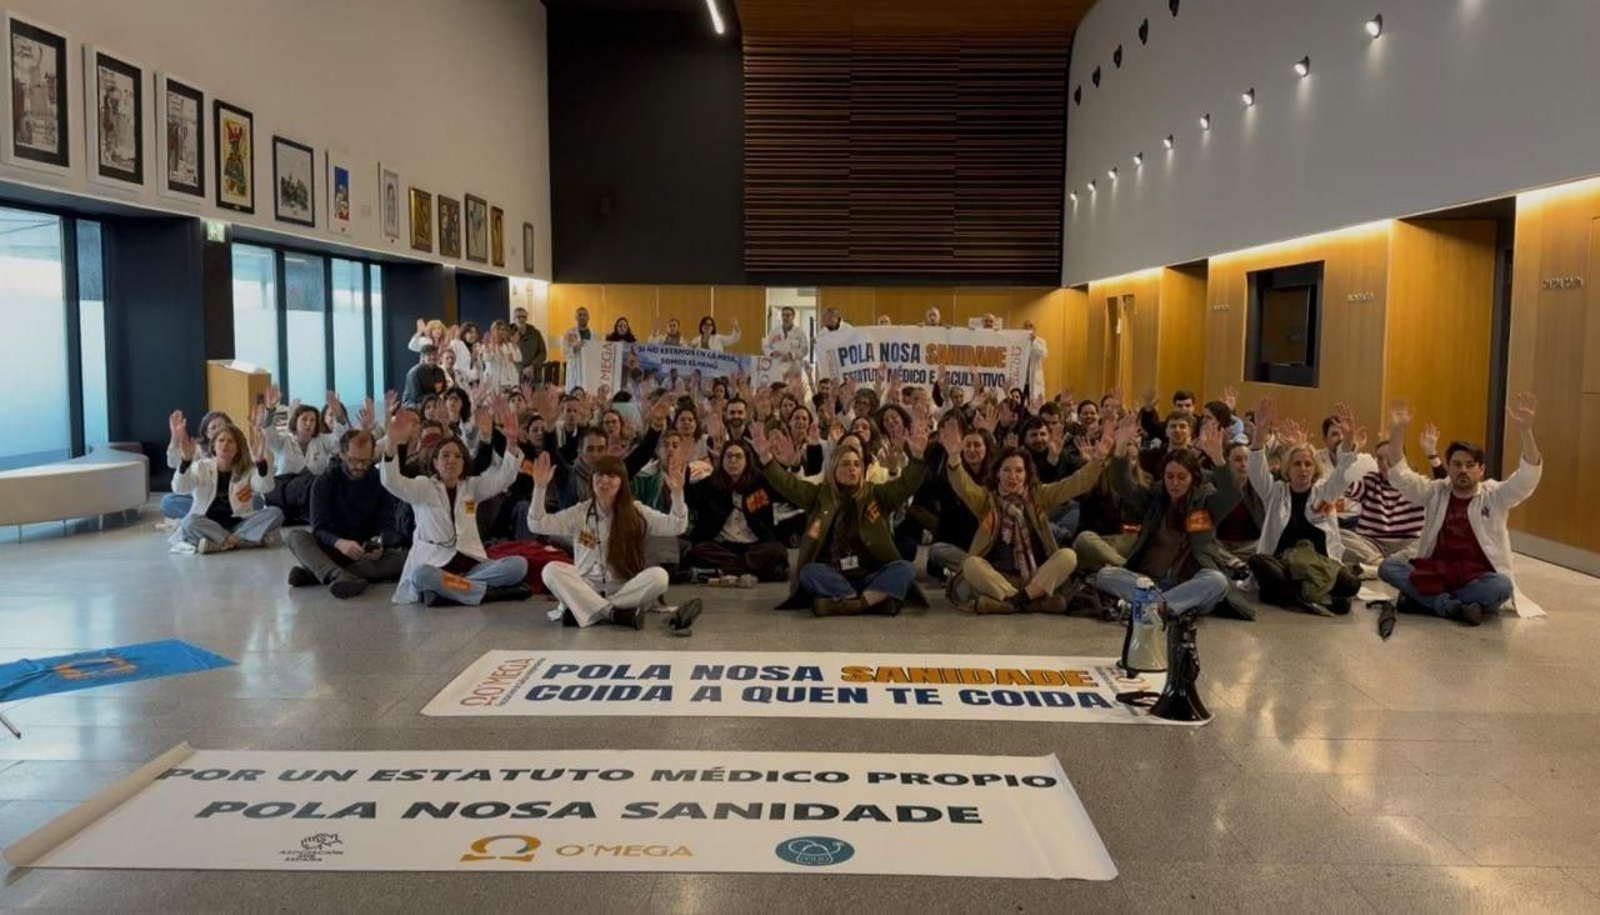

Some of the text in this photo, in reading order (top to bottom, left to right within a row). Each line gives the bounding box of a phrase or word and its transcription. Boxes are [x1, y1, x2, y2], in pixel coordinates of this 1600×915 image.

[838, 342, 875, 367] POLA
[879, 342, 921, 363] NOSA
[925, 342, 1007, 369] SANIDADE
[929, 370, 936, 384] E
[541, 664, 1099, 687] POLA NOSA SANIDADE
[524, 685, 1114, 709] COIDA A QUEN TE COIDA
[154, 766, 1058, 788] POR UN ESTATUTO MÉDICO PROPIO
[194, 801, 984, 825] POLA NOSA SANIDADE
